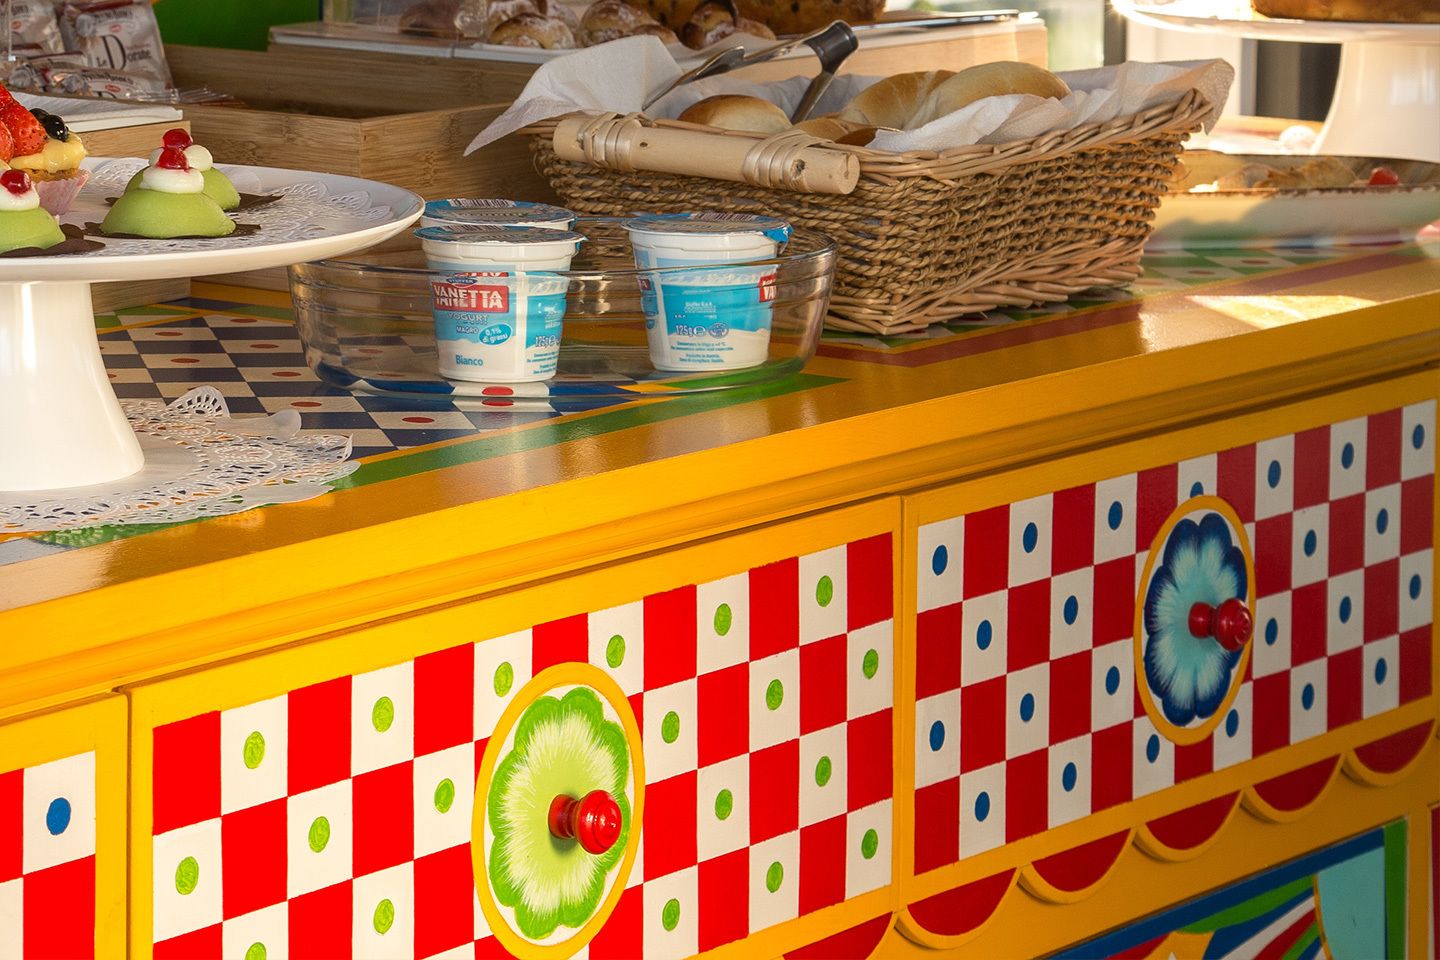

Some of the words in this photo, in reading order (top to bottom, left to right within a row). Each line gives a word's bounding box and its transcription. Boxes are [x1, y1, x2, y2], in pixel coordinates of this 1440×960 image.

[433, 284, 504, 309] VANETTA
[448, 313, 488, 321] YOGURT
[455, 354, 484, 366] Bianco
